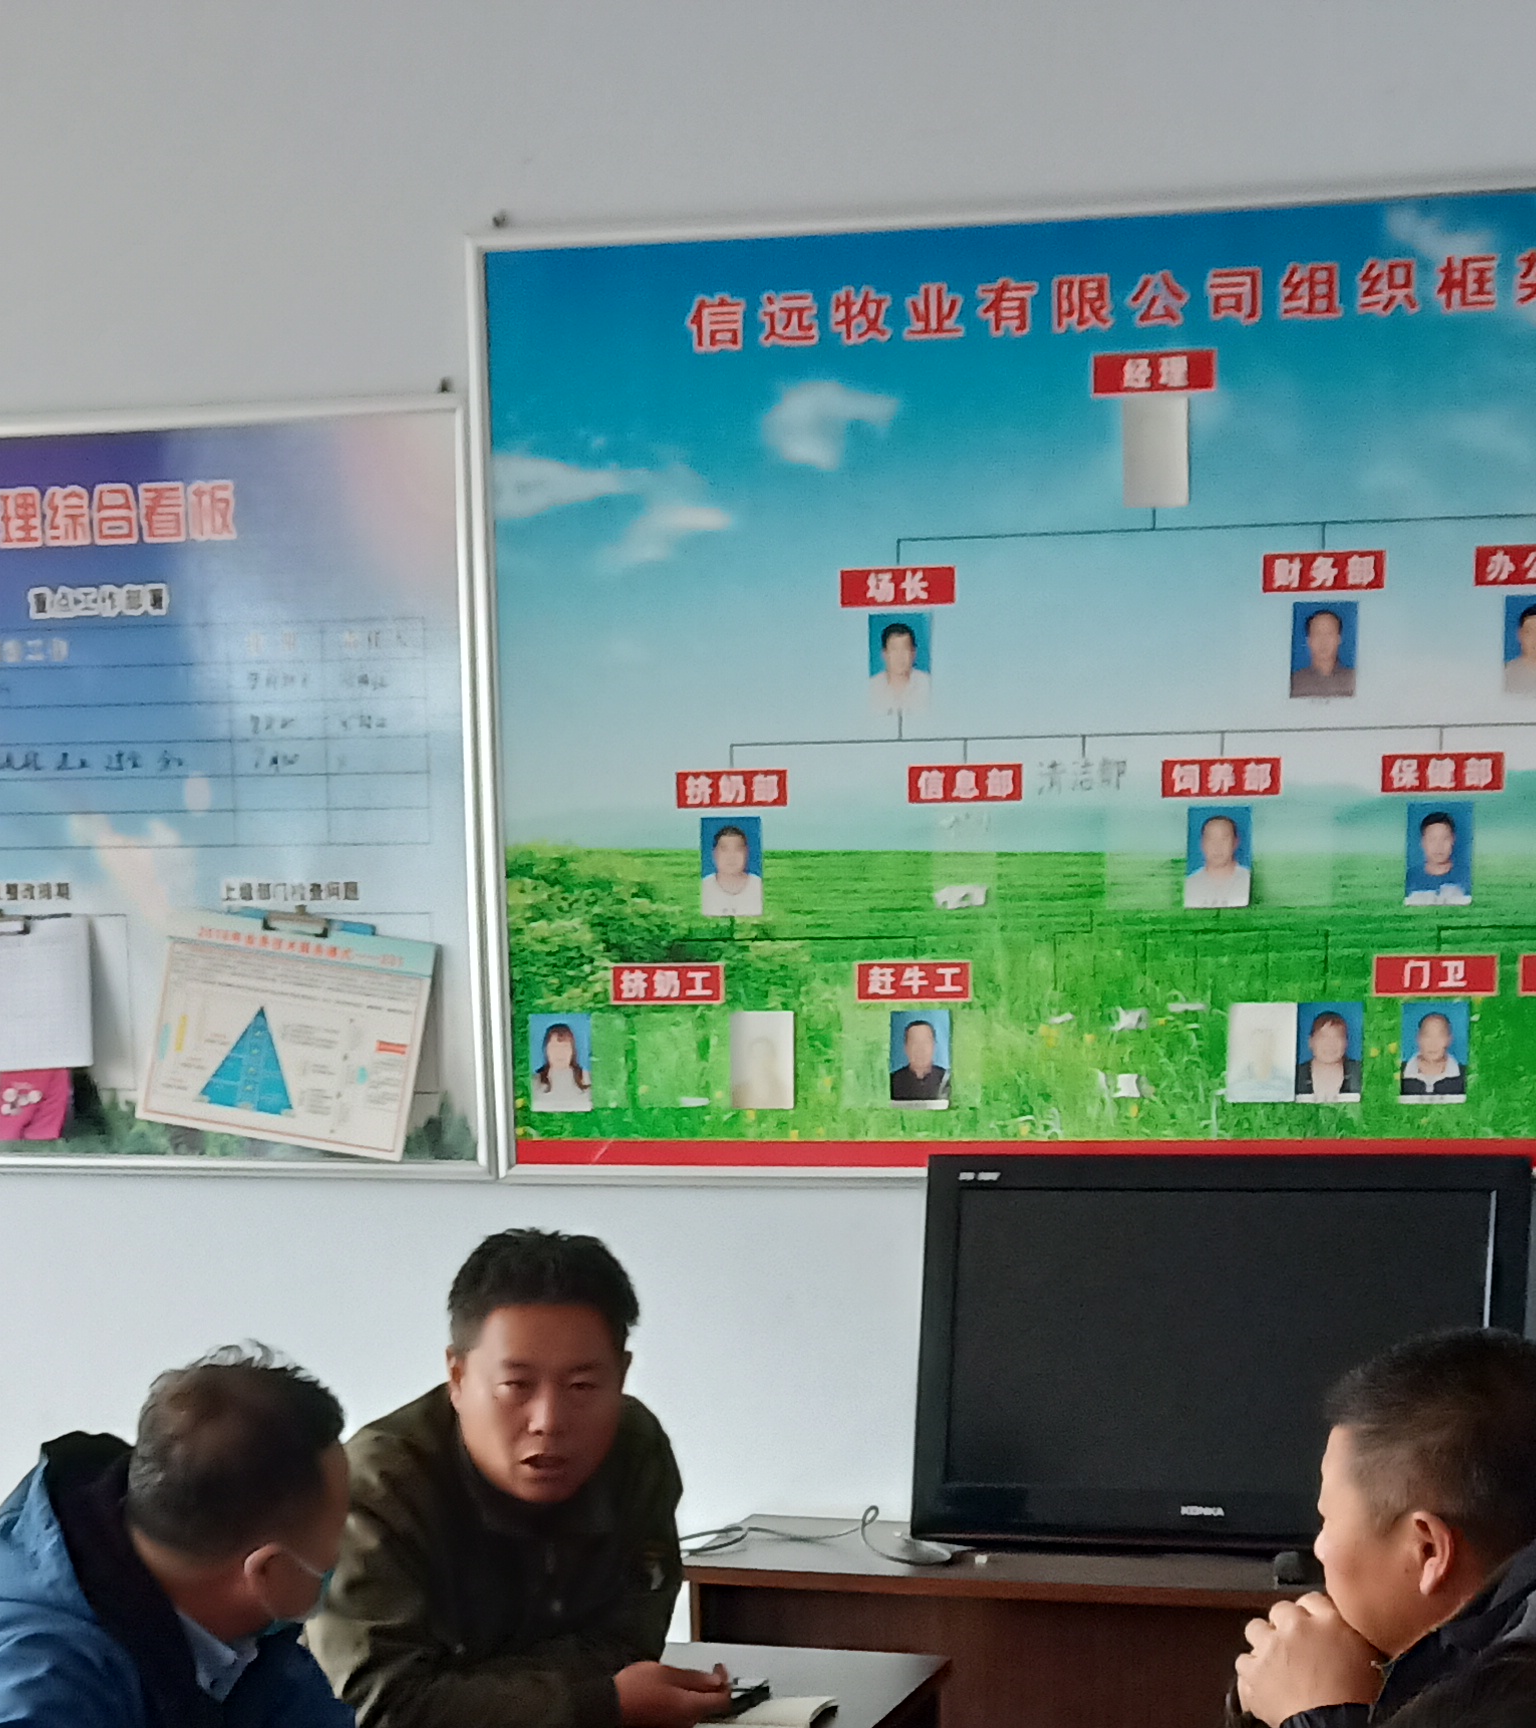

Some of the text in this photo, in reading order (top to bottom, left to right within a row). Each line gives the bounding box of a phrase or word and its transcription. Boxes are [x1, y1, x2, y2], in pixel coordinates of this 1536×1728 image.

[1122, 355, 1189, 390] 经理
[866, 570, 930, 602] 场长
[1273, 555, 1378, 588] 财务部
[917, 768, 1015, 798] 信息部
[1170, 762, 1274, 793] 饲养部
[1389, 757, 1494, 789] 保健部
[685, 775, 780, 805] 挤奶部
[620, 969, 714, 998] 挤奶工
[867, 966, 964, 996] 赶牛工
[1403, 958, 1468, 990] 门卫
